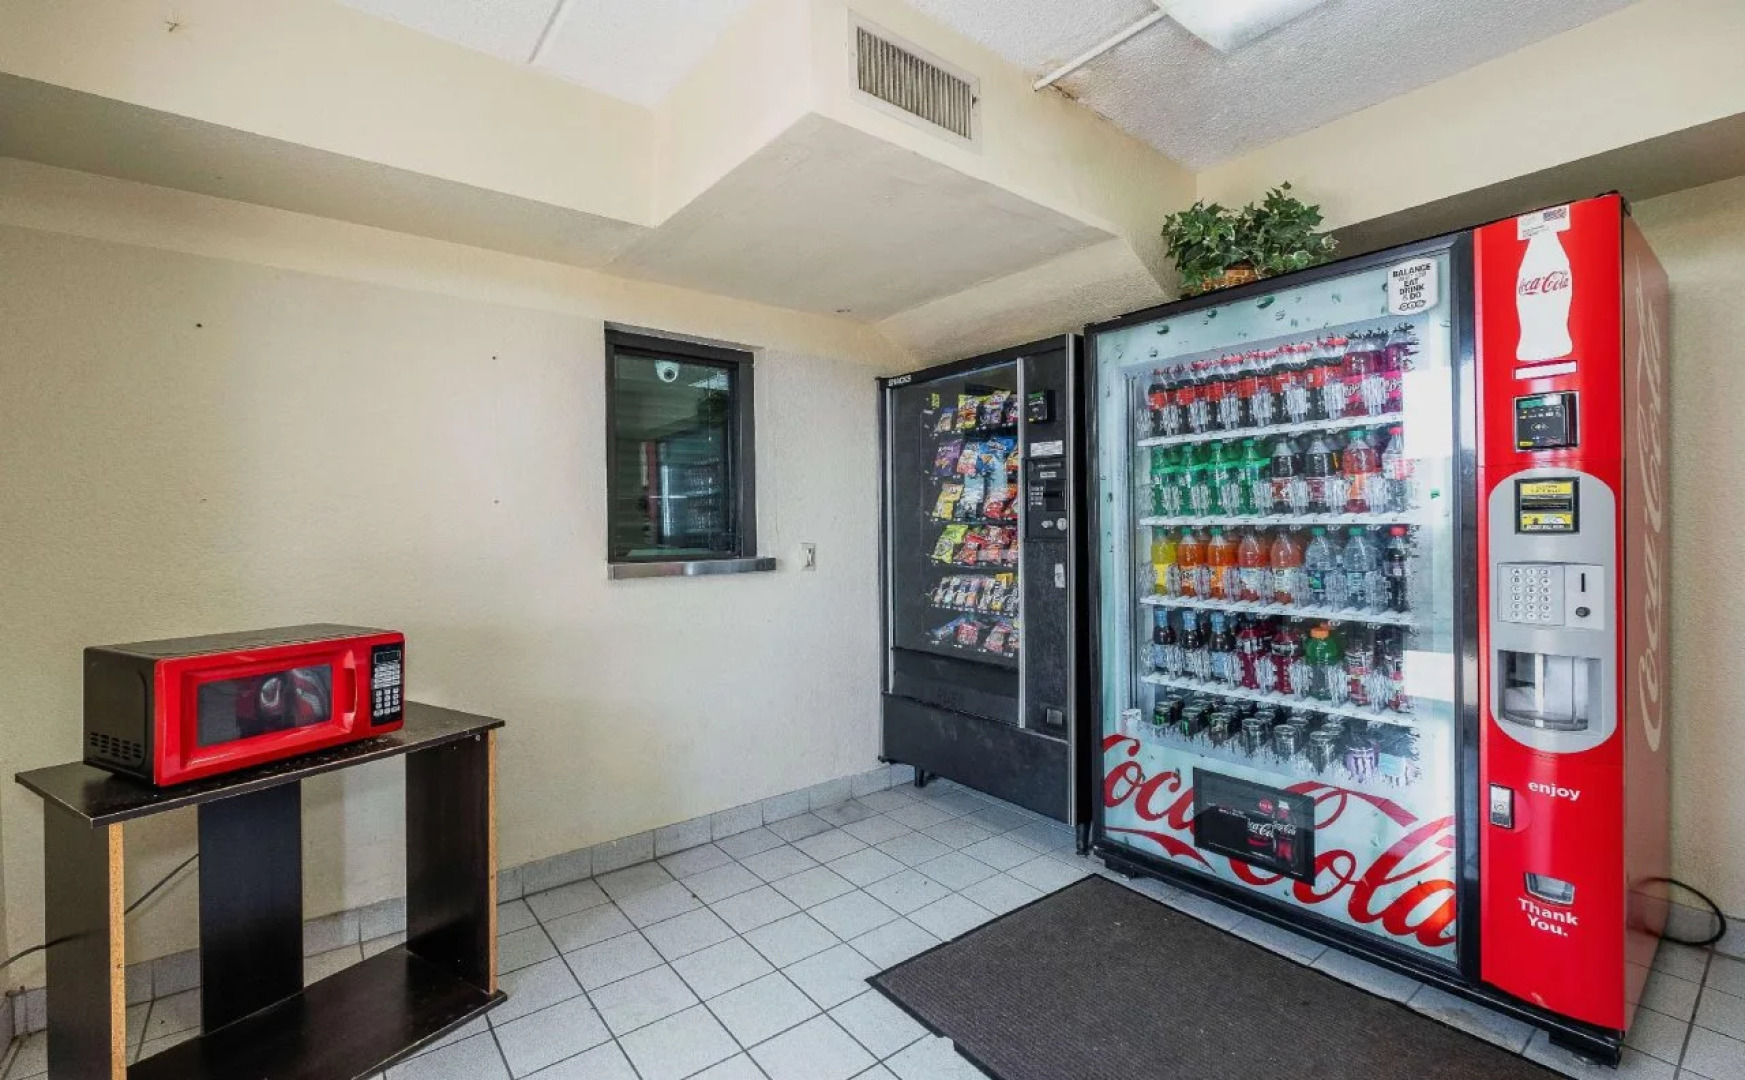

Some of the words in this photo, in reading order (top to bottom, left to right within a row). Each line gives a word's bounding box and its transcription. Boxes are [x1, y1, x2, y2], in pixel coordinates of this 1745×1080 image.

[1392, 262, 1432, 278] BALANCE
[1399, 283, 1425, 296] DRINK
[1403, 277, 1420, 287] EAT
[1410, 291, 1422, 300] DO
[1527, 781, 1581, 802] enjoy
[1518, 897, 1579, 926] Thank
[1527, 914, 1569, 937] You.
